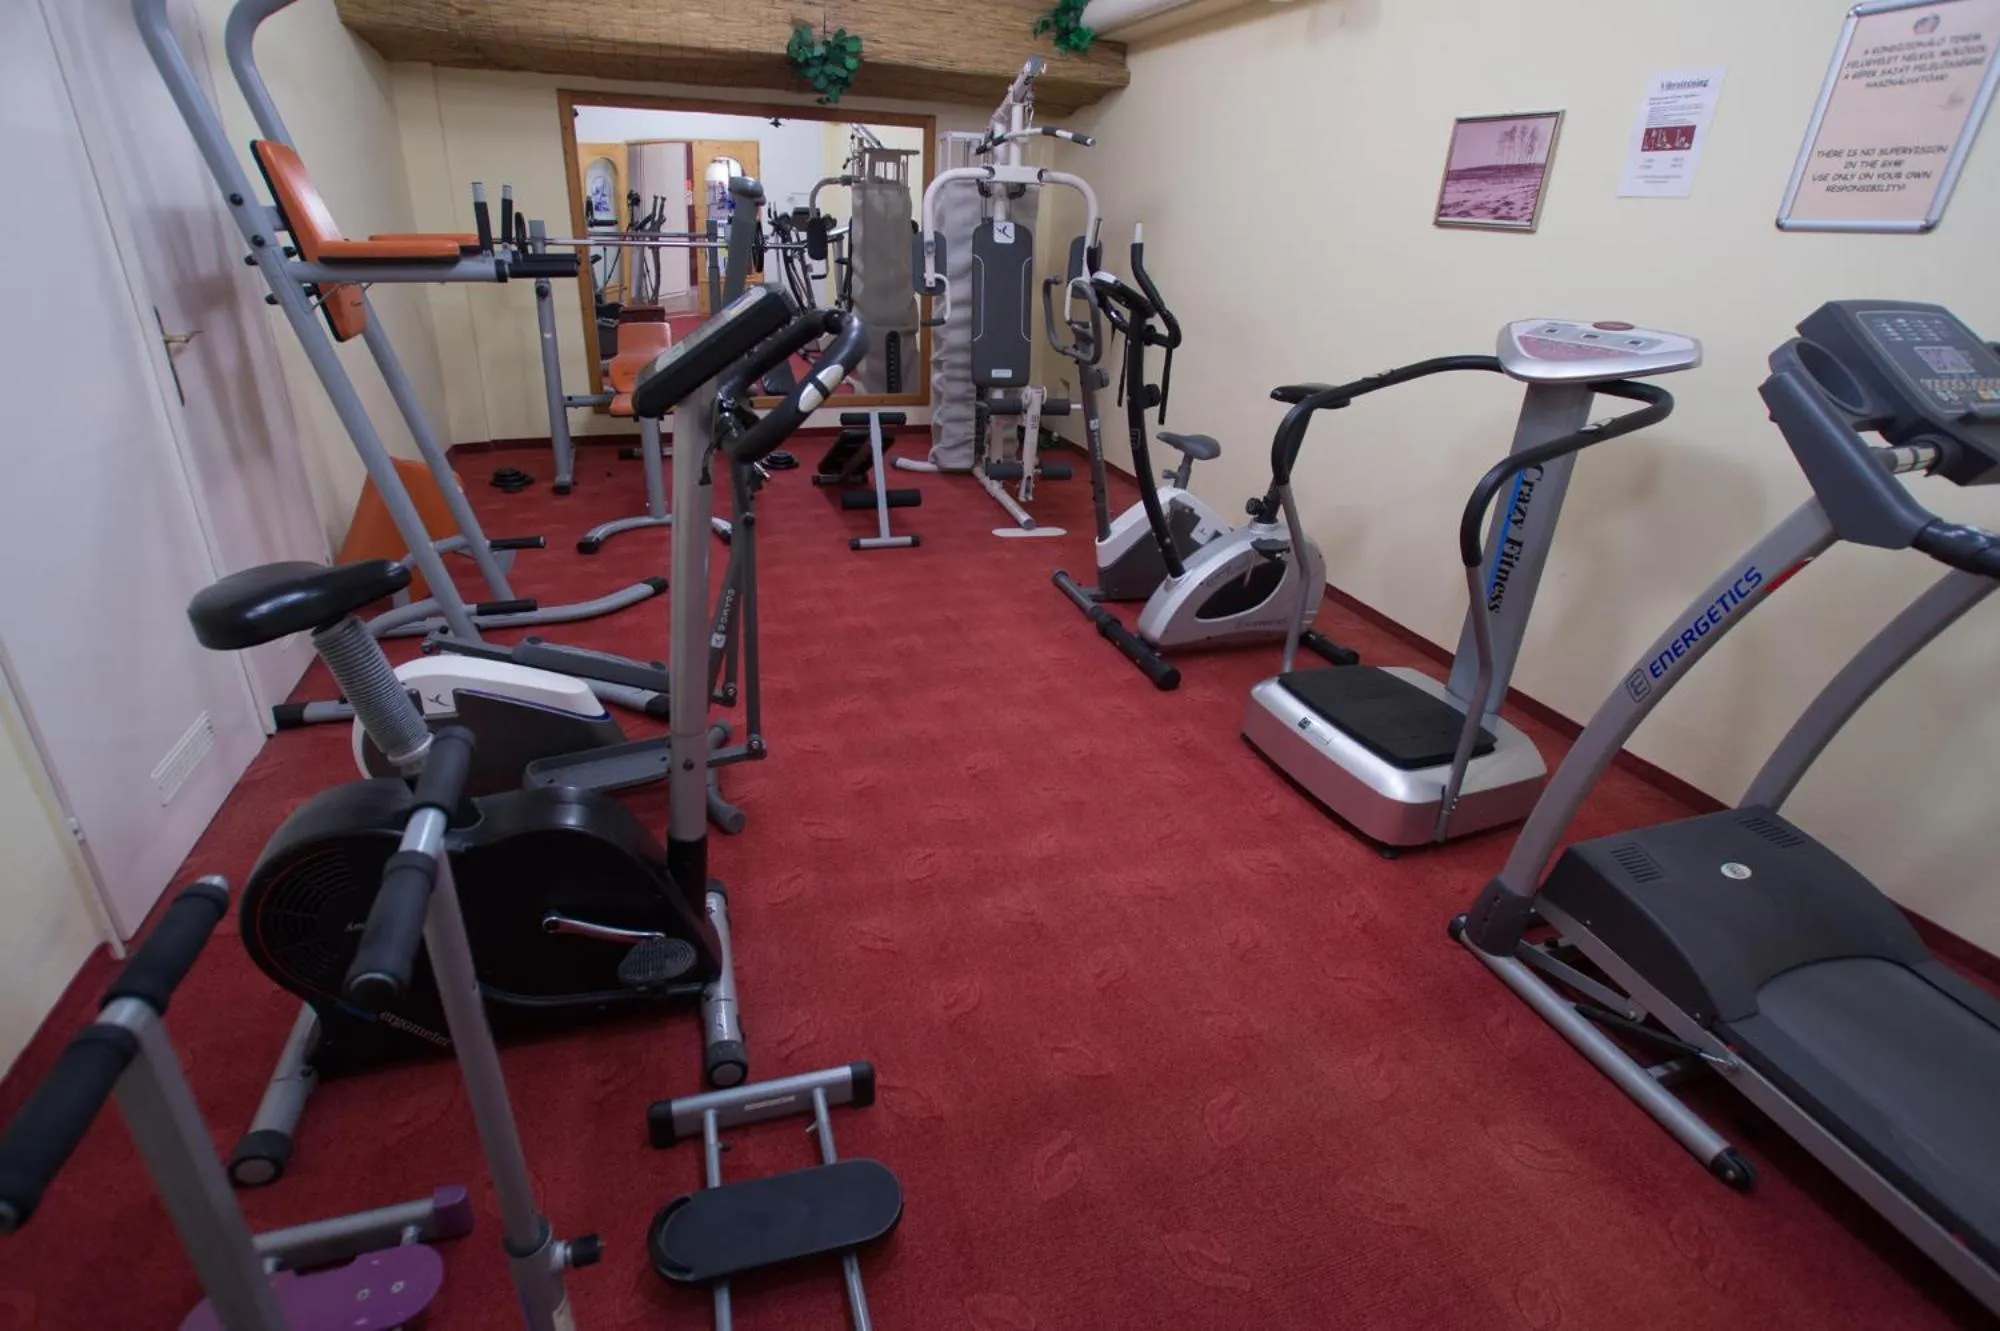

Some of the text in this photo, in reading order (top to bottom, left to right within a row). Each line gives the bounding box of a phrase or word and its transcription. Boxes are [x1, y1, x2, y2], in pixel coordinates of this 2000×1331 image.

[1816, 144, 1949, 158] THERE IS NO SUPERVISION
[1843, 160, 1857, 169] IN
[1859, 159, 1879, 169] THE
[1812, 170, 1933, 182] USE ONLY ON YOUR OWN
[1487, 463, 1544, 615] Crazy Fitness
[1649, 565, 1763, 679] ENERGETICS
